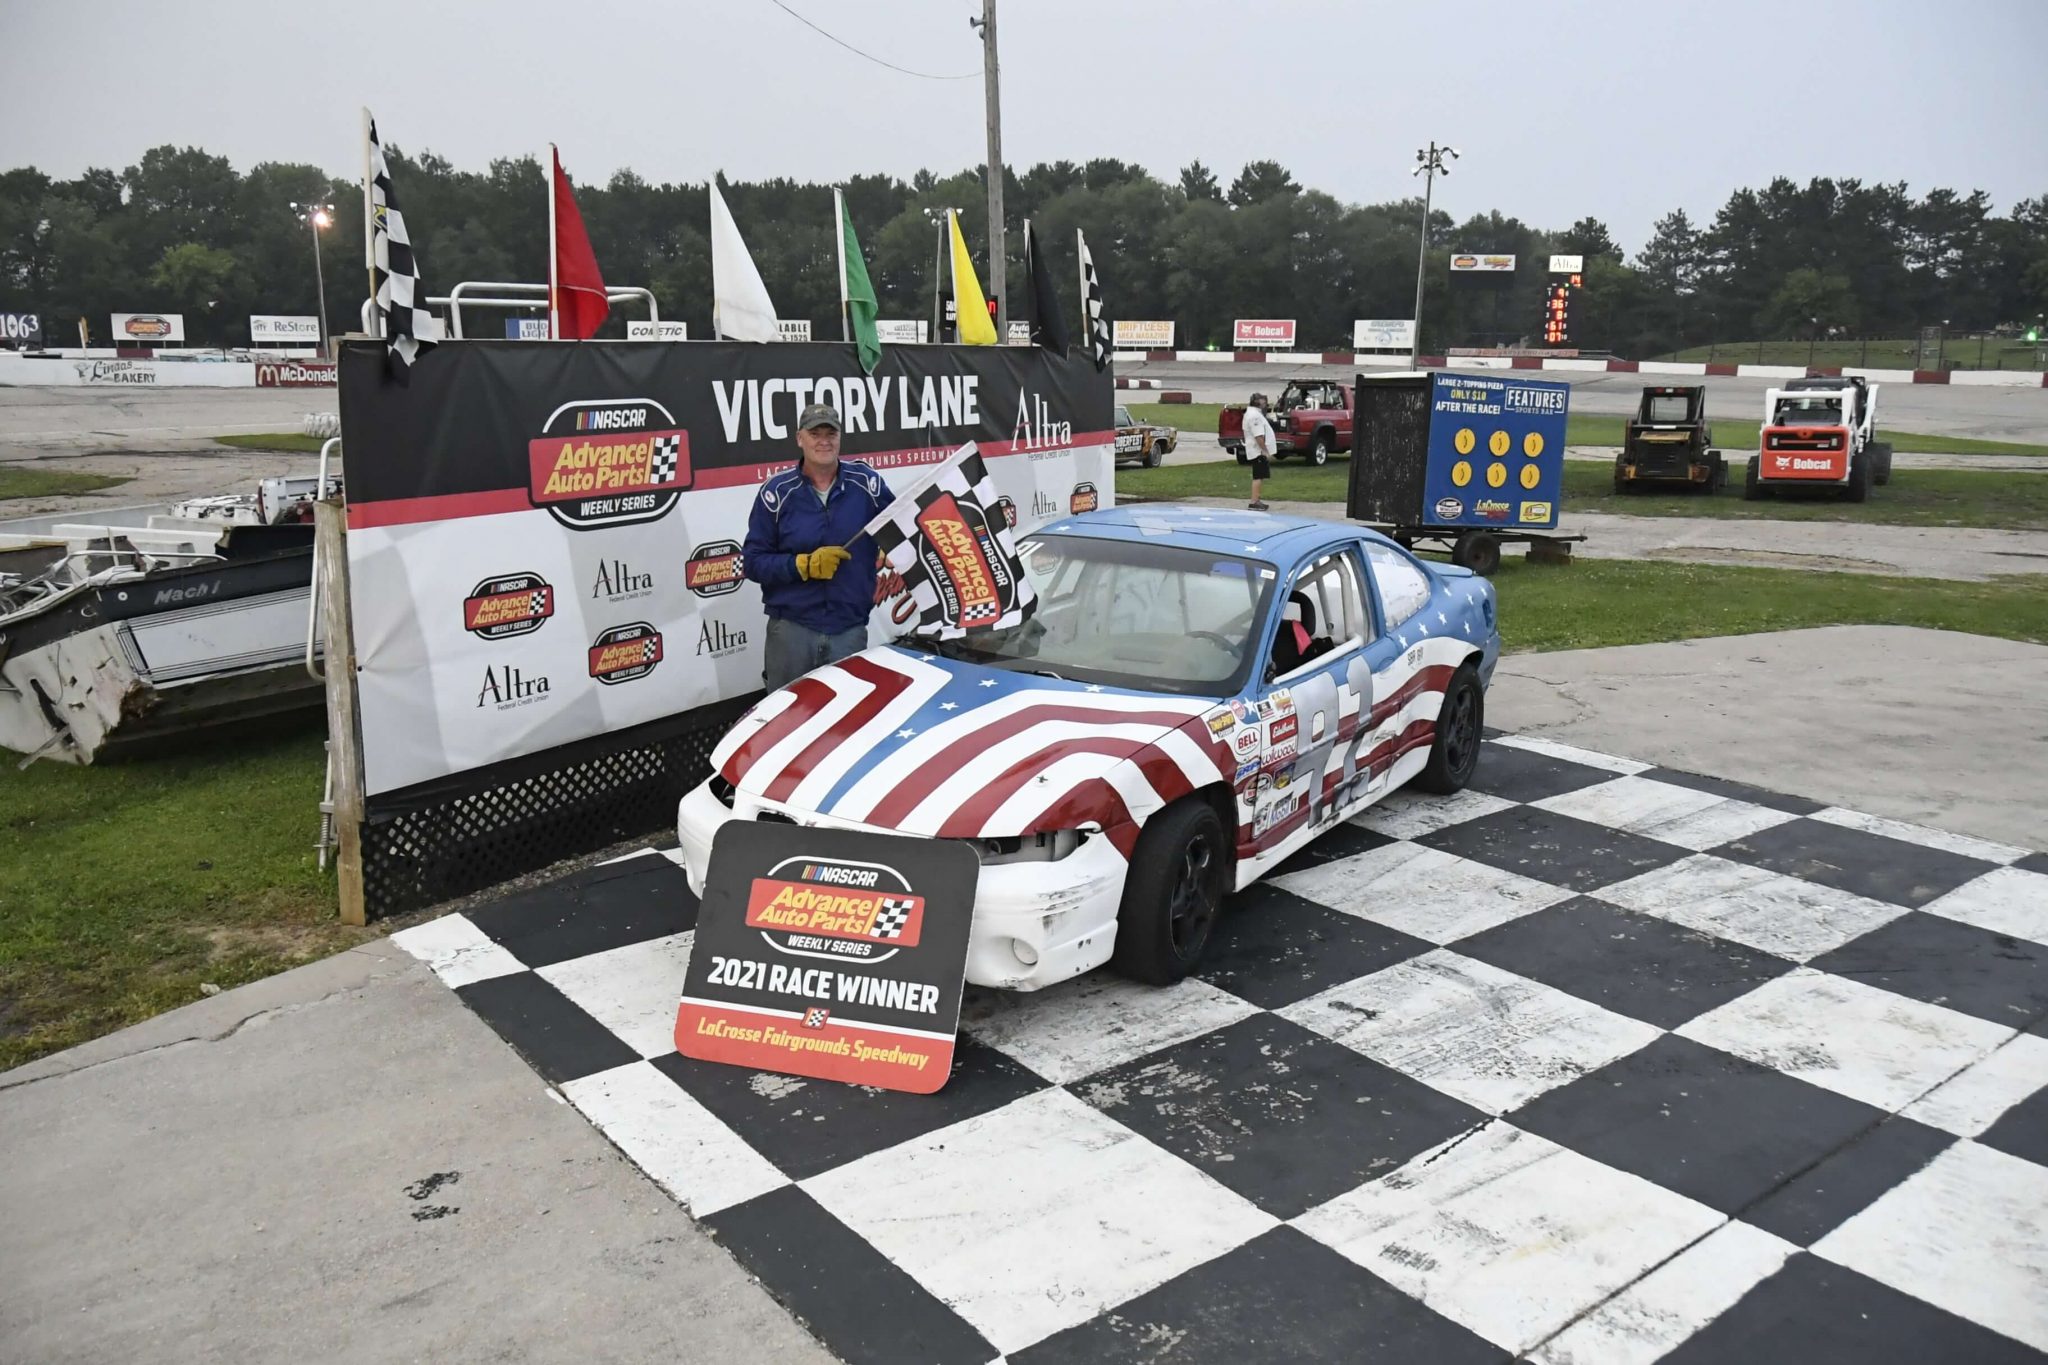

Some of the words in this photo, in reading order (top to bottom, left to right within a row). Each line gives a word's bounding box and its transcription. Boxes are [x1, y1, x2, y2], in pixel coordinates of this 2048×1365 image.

[274, 321, 317, 332] ReStore
[522, 330, 548, 338] LIGH
[526, 322, 548, 330] BUD
[778, 323, 808, 333] LABLE
[1117, 322, 1170, 331] DRIFTLESS
[1255, 326, 1284, 336] Bobcat
[113, 373, 156, 384] BAKERY
[280, 366, 338, 382] McDonald
[899, 375, 981, 430] LANE
[1450, 389, 1470, 400] ONLY
[1471, 390, 1487, 401] $10
[1507, 390, 1563, 409] FEATURES
[1435, 401, 1460, 412] AFTER
[1461, 402, 1477, 413] THE
[1477, 404, 1501, 415] RACE!
[593, 409, 647, 429] NASCAR
[1010, 386, 1073, 452] Altra
[554, 442, 647, 470] Advance
[1793, 458, 1831, 470] Bobcat
[543, 470, 594, 495] Auto
[595, 464, 645, 489] Parts
[581, 498, 622, 516] WEEKLY
[622, 494, 656, 511] SERIES
[1032, 489, 1057, 516] Altra
[697, 559, 731, 574] Advance
[924, 519, 954, 557] Auto
[947, 556, 975, 601] Parts
[940, 519, 989, 598] Advance
[981, 541, 1009, 587] NASCAR
[499, 579, 528, 592] NASCAR
[592, 558, 654, 599] Altra
[691, 573, 711, 585] Auto
[711, 569, 730, 581] Parts
[925, 551, 951, 586] WEEKLY
[944, 584, 960, 615] SERIES
[154, 583, 209, 605] Mach
[478, 595, 528, 613] Advance
[472, 612, 499, 625] Auto
[500, 607, 527, 620] Parts
[491, 623, 513, 634] WEEKLY
[513, 620, 533, 630] SERIES
[696, 618, 748, 656] Altra
[600, 643, 642, 661] Advance
[595, 660, 617, 672] Auto
[618, 654, 641, 667] Parts
[476, 664, 551, 708] Altra
[497, 701, 516, 711] Federal
[517, 697, 533, 706] Credit
[534, 694, 549, 702] Union
[1238, 732, 1258, 749] BELL
[819, 865, 879, 888] NASCAR
[770, 886, 874, 917] Advance
[755, 904, 809, 928] Auto
[808, 910, 865, 935] Parts
[787, 934, 832, 951] WEEKLY
[831, 940, 872, 956] SERIES
[707, 956, 766, 989] 2021
[769, 964, 832, 1000] RACE
[836, 972, 940, 1015] WINNER
[696, 1016, 762, 1043] LaCrosse
[762, 1025, 852, 1058] Fairgrounds
[851, 1039, 930, 1071] Speedway
